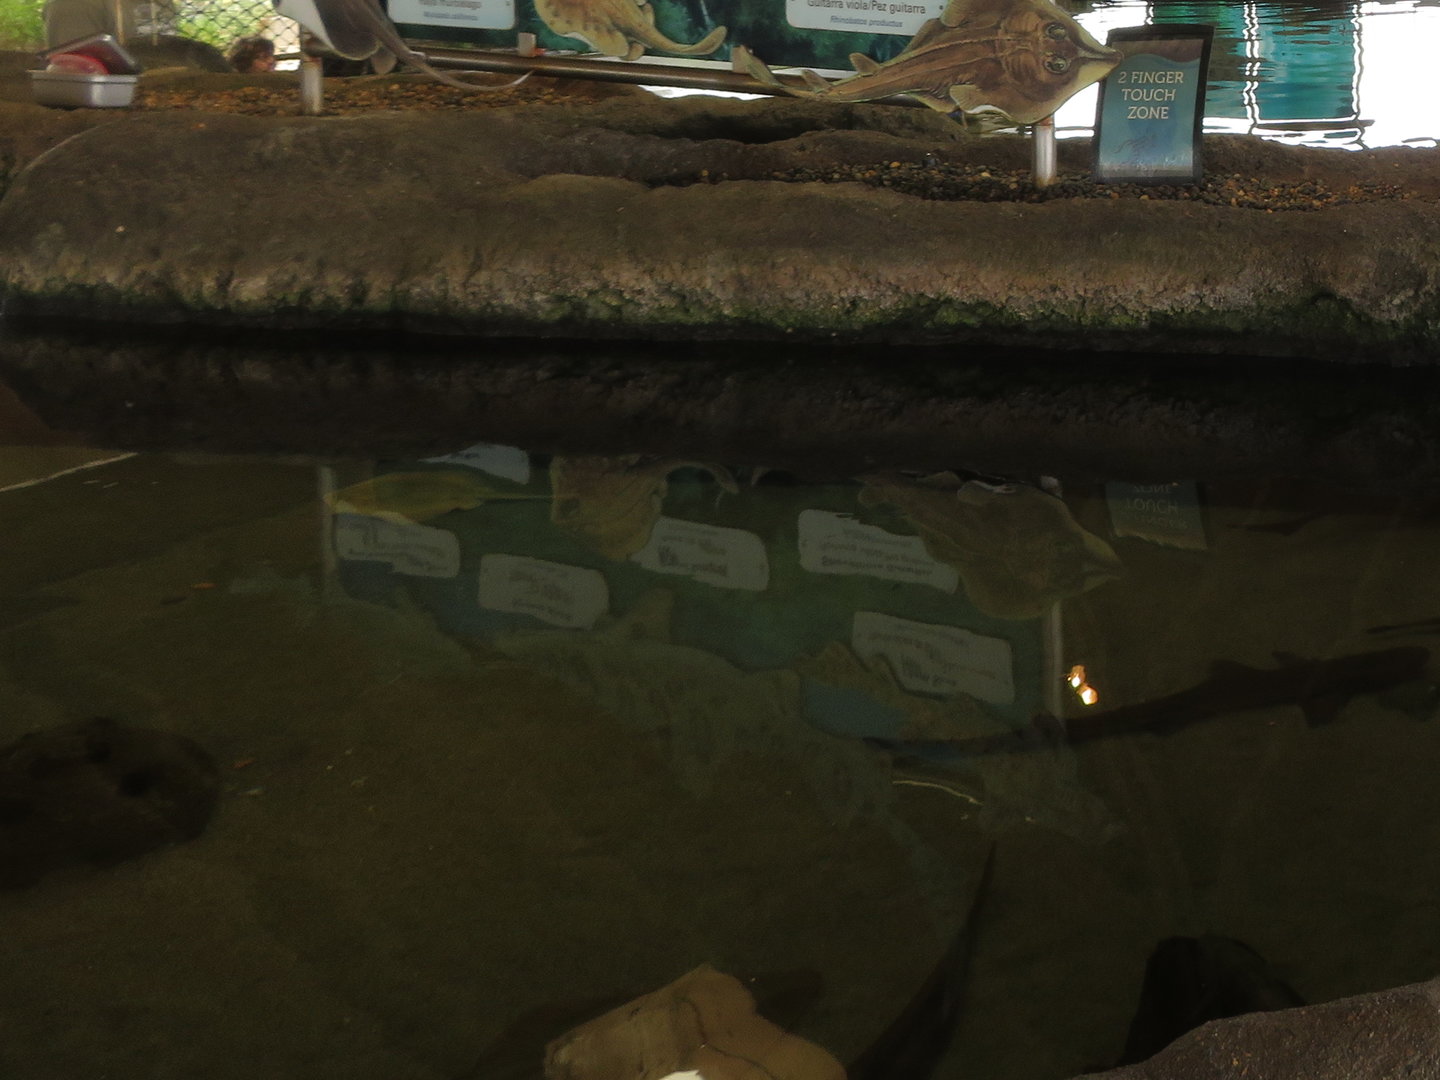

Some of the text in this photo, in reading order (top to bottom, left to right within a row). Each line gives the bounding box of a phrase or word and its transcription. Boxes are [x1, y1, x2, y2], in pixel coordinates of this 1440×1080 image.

[889, 1, 926, 15] guitarra
[1117, 70, 1184, 84] 2 FINGER
[1120, 87, 1177, 101] TOUCH
[1127, 105, 1170, 120] ZONE
